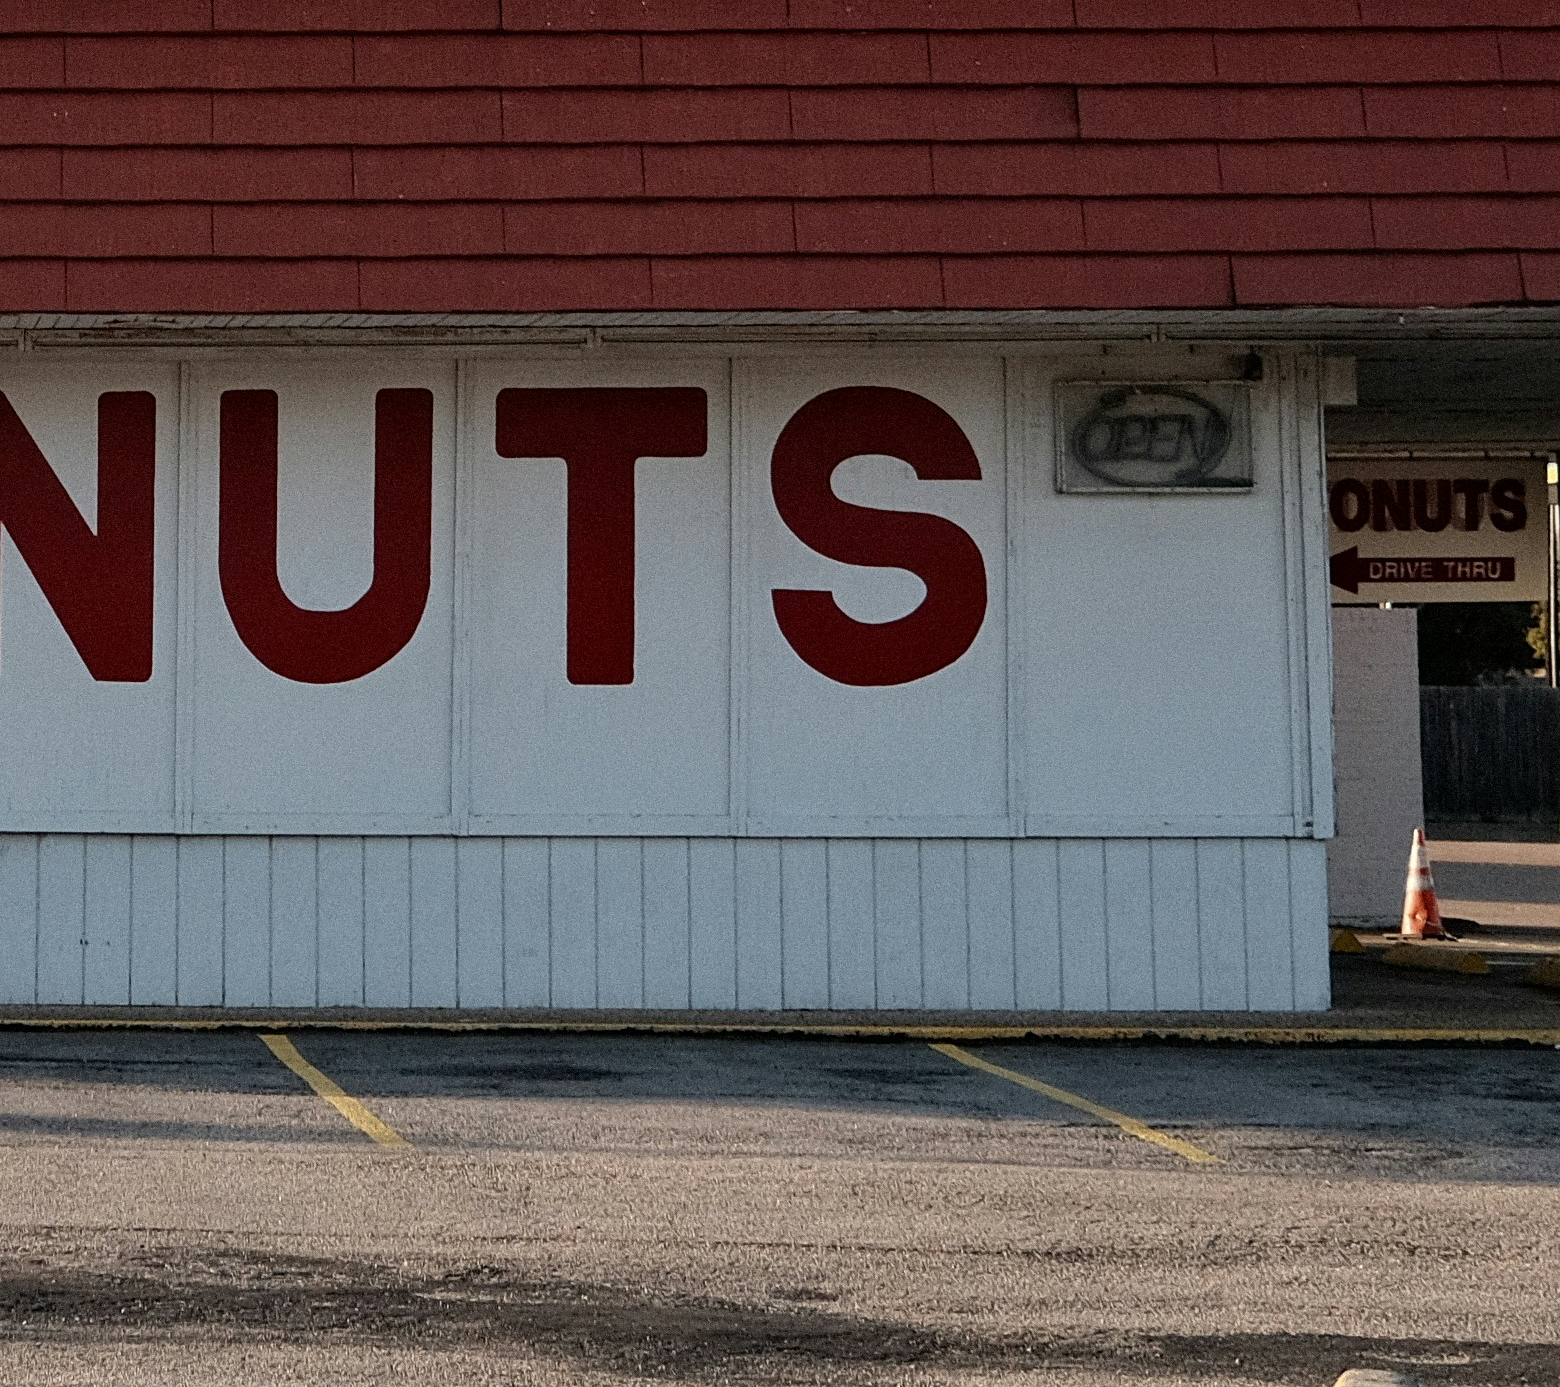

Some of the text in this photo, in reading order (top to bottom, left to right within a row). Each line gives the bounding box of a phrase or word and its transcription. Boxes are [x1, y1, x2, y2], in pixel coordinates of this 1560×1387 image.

[1079, 413, 1211, 463] OPEN
[1329, 478, 1528, 532] ONUTS
[1369, 561, 1502, 579] DRIVE THRU
